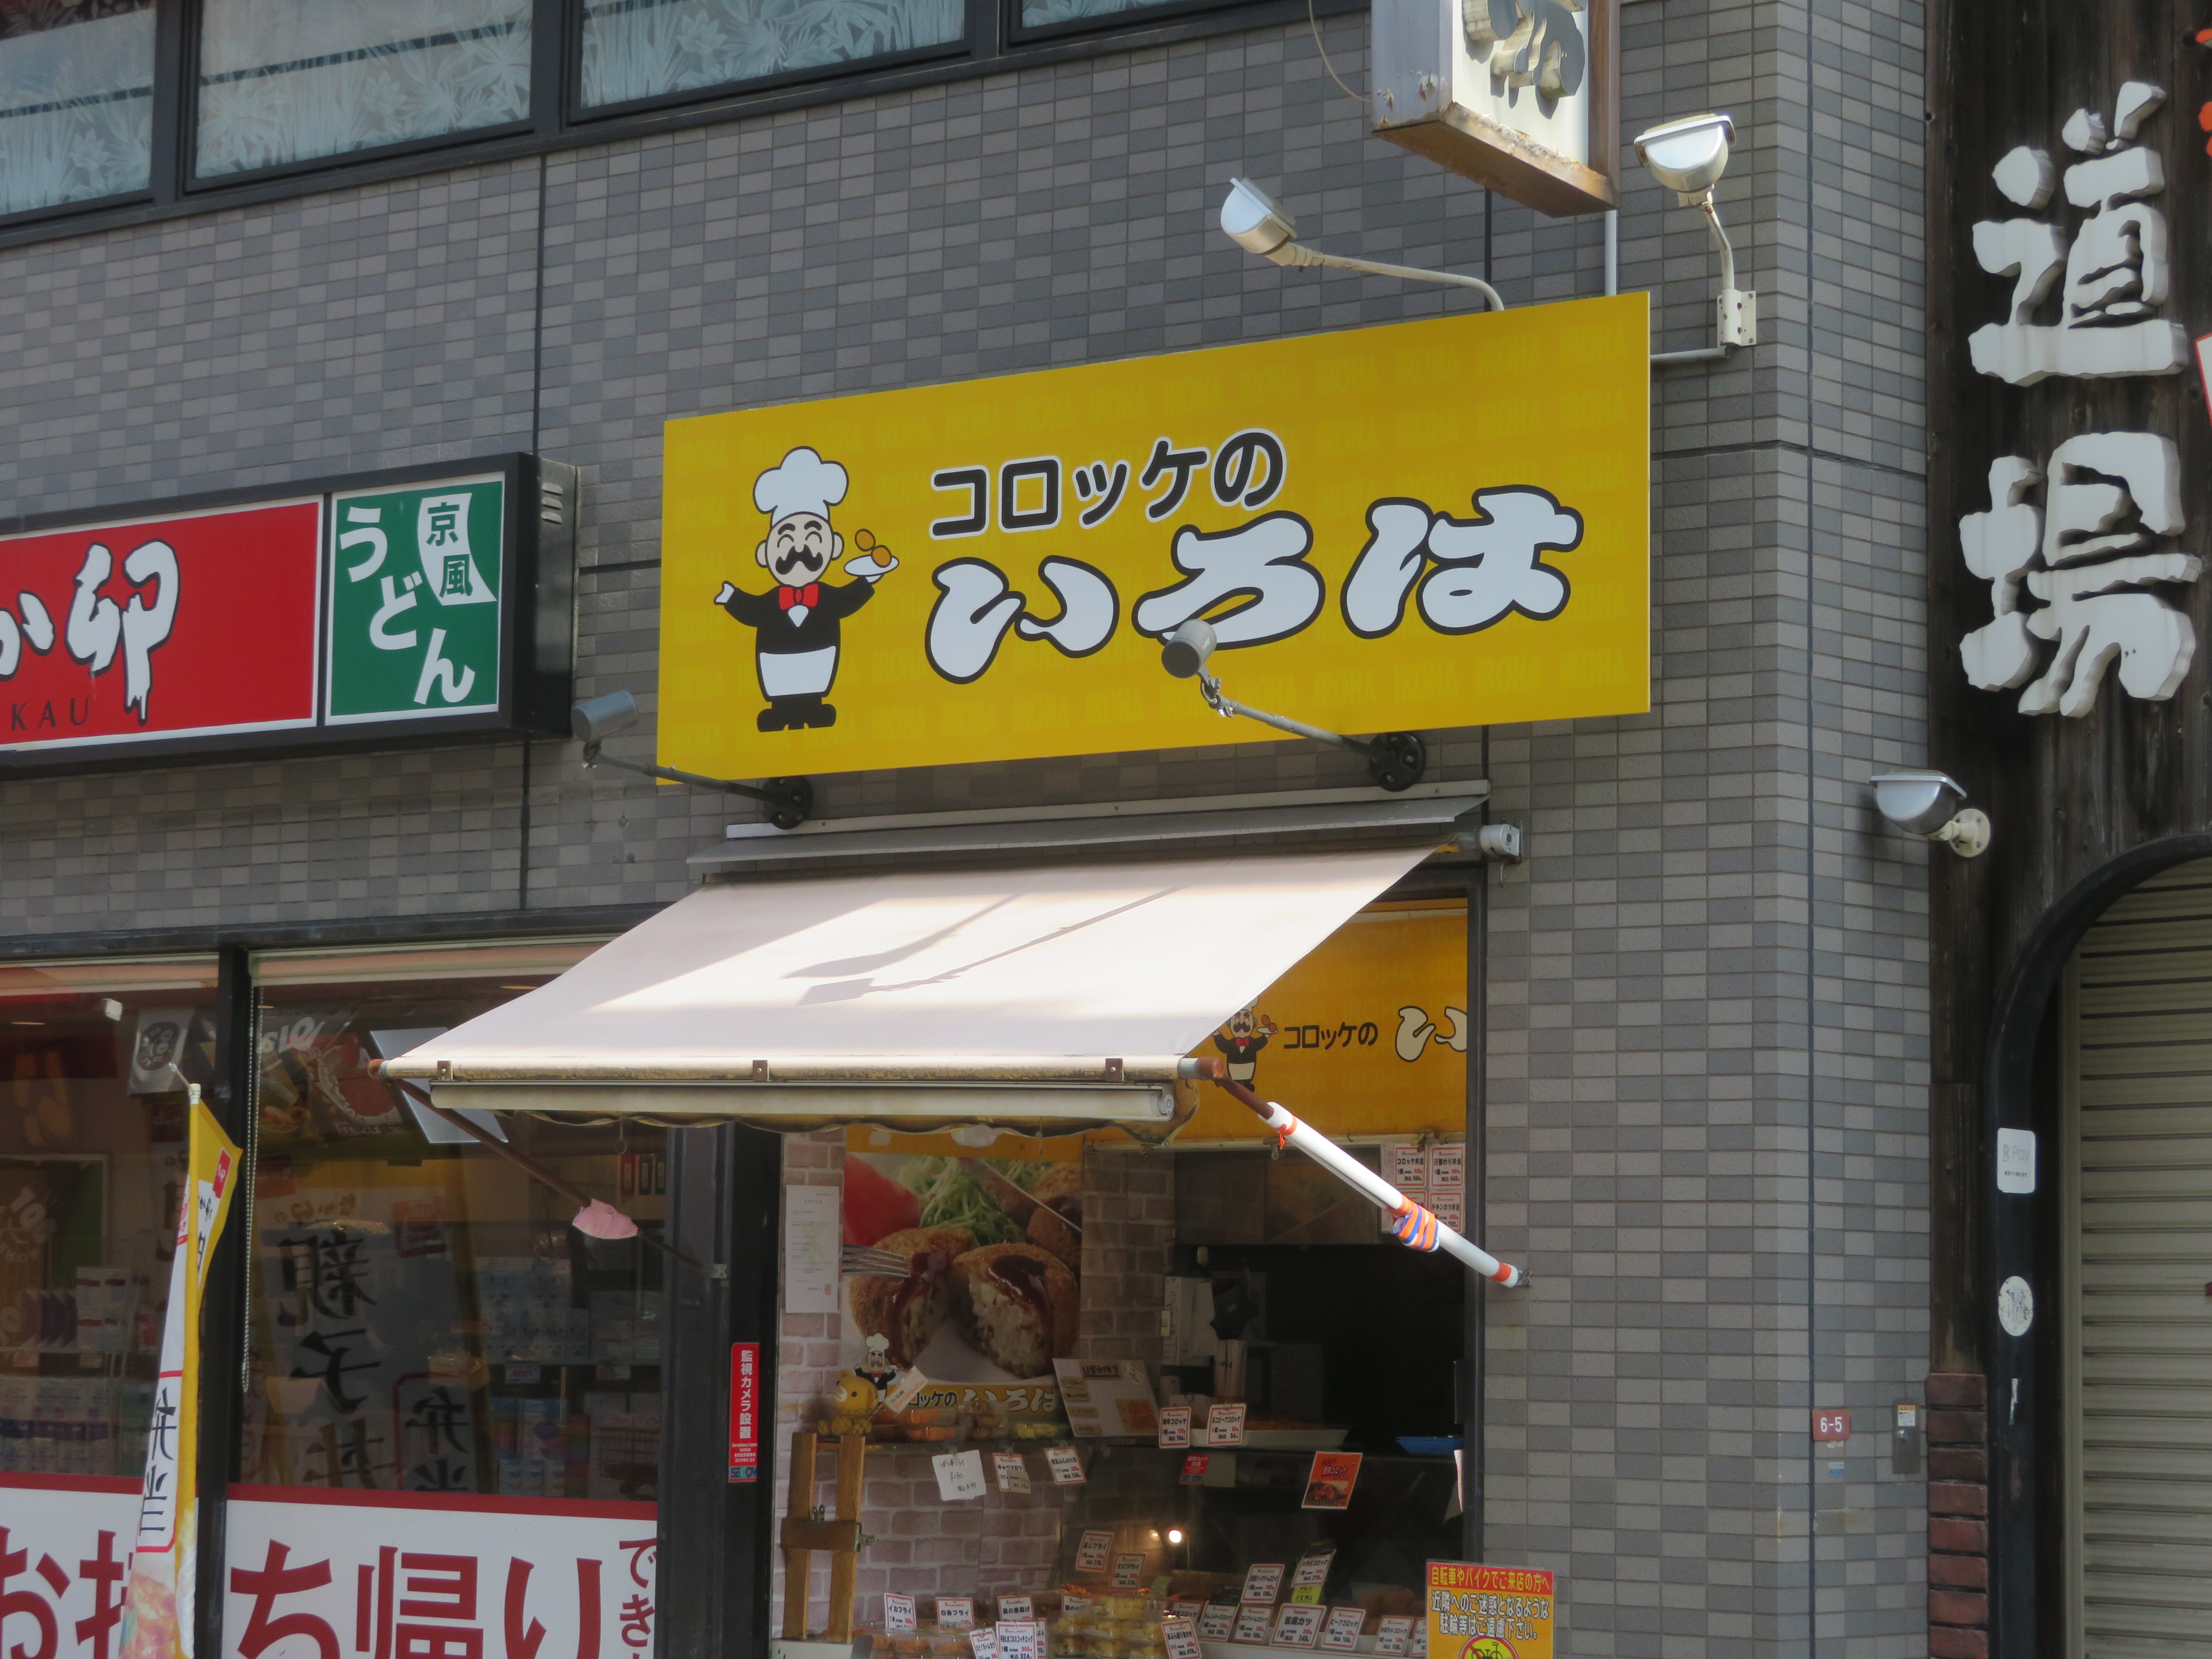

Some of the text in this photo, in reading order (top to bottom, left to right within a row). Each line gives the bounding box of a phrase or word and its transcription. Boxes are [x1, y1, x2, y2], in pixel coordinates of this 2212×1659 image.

[1959, 81, 2204, 718] 道場
[929, 428, 1286, 540] コロッケの
[426, 503, 472, 597] 京風
[925, 484, 1584, 684] いろは
[340, 507, 475, 706] うどん
[1284, 1022, 1378, 1050] コロッケの
[739, 1350, 753, 1439] 監視カメラ設置
[1820, 1417, 1842, 1432] 6-5
[1431, 1566, 1550, 1592] 自転車やバイクでご来店の方へ
[619, 1538, 657, 1659] でき
[889, 1605, 911, 1614] イカフライ
[1432, 1590, 1549, 1620] 近隣へのご迷惑となるような
[1284, 1616, 1312, 1625] 豆腐カツ
[1330, 1619, 1358, 1627] ビーフコロッケ
[1439, 1612, 1537, 1640] 駐輪等はご遠慮下さい。
